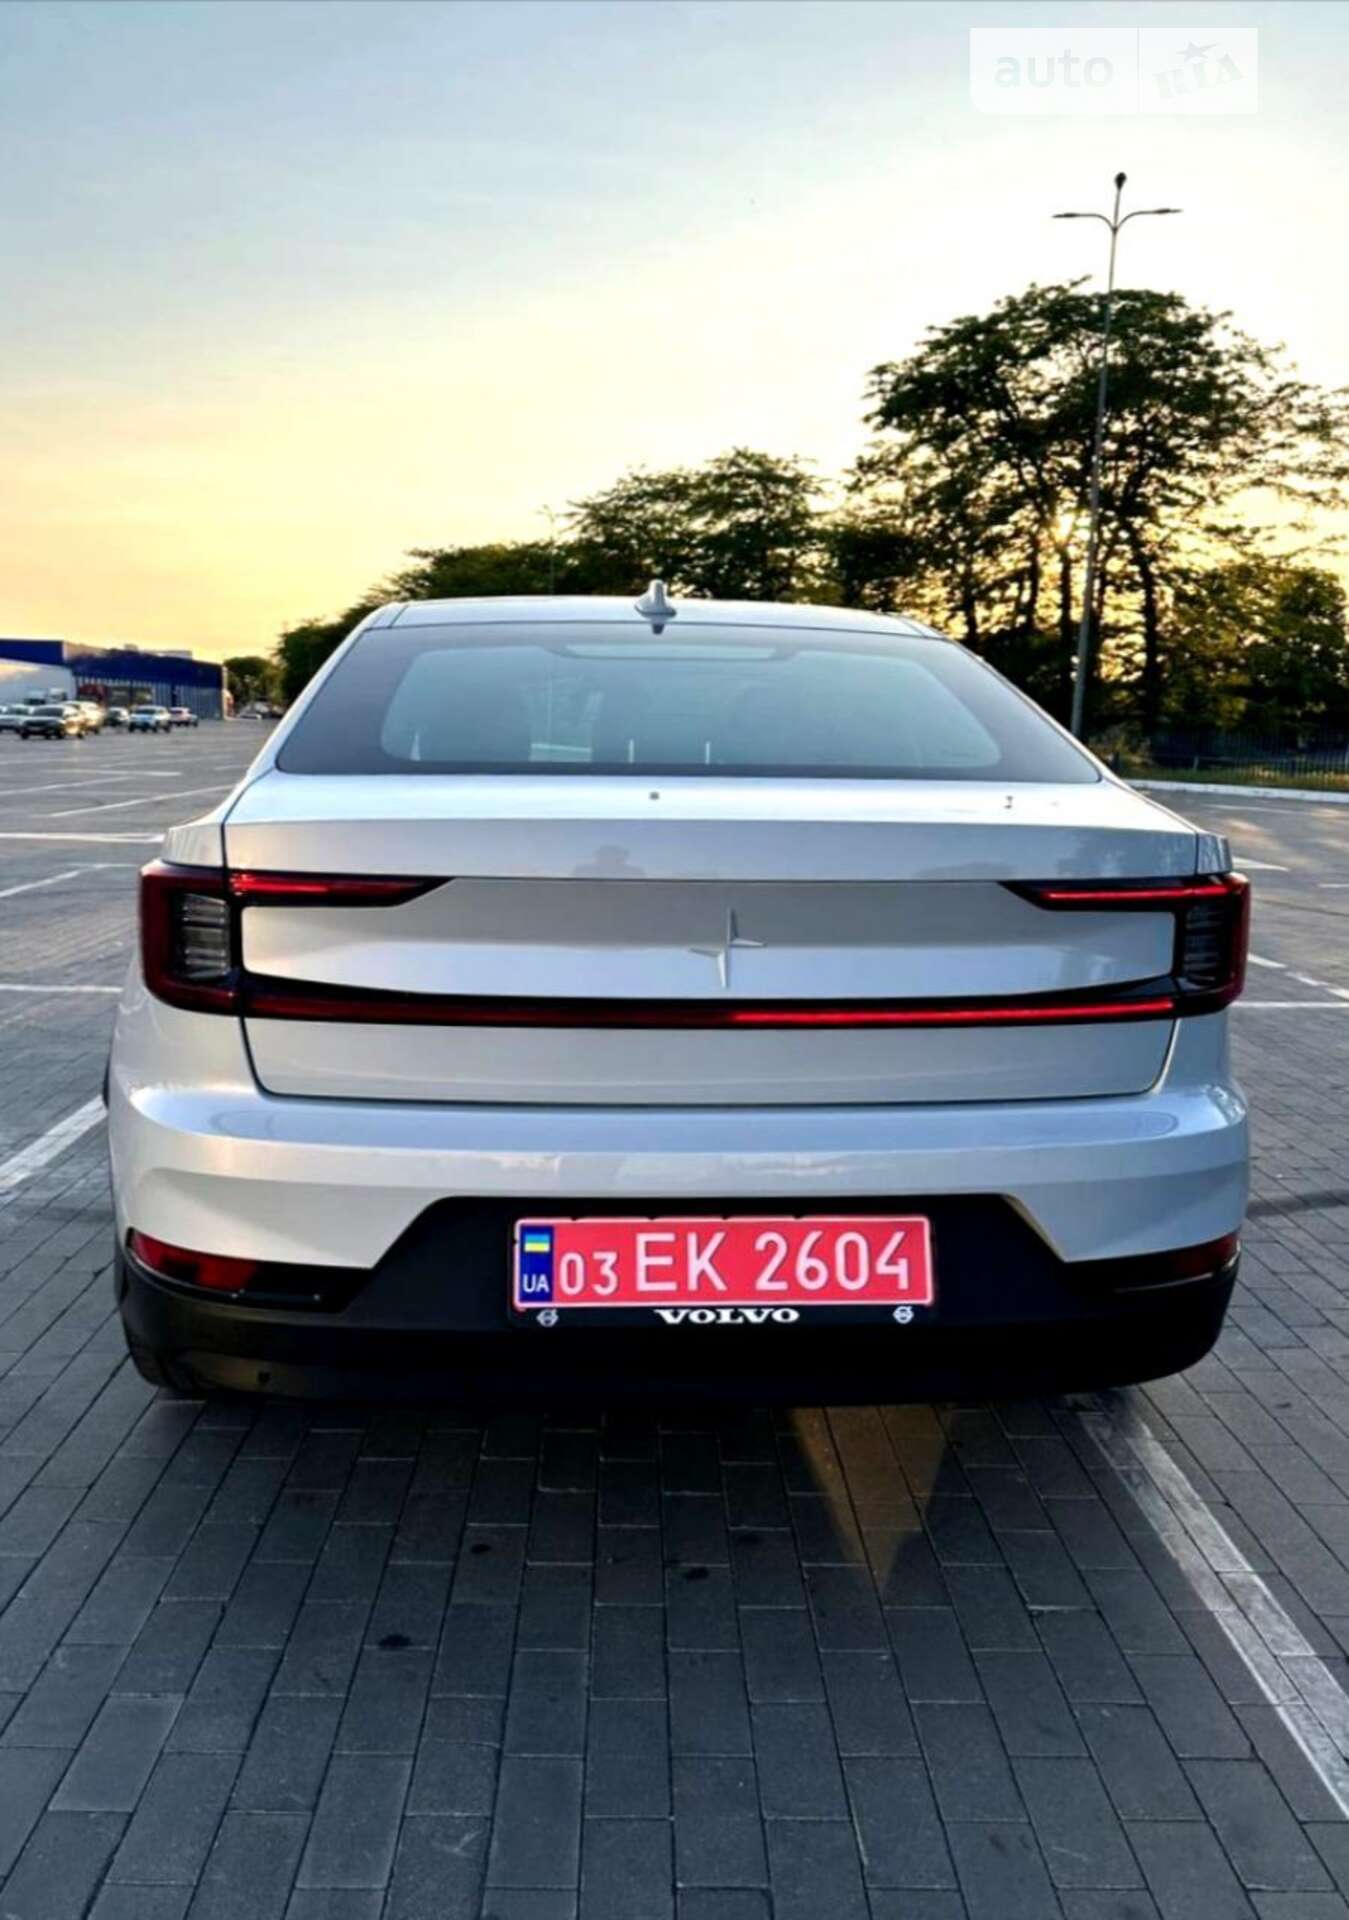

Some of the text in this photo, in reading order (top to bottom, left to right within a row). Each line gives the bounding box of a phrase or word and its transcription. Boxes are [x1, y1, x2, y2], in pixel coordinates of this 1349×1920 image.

[560, 1231, 910, 1295] 03 EK 2604
[523, 1274, 550, 1293] UA
[655, 1308, 800, 1324] VOLVO
